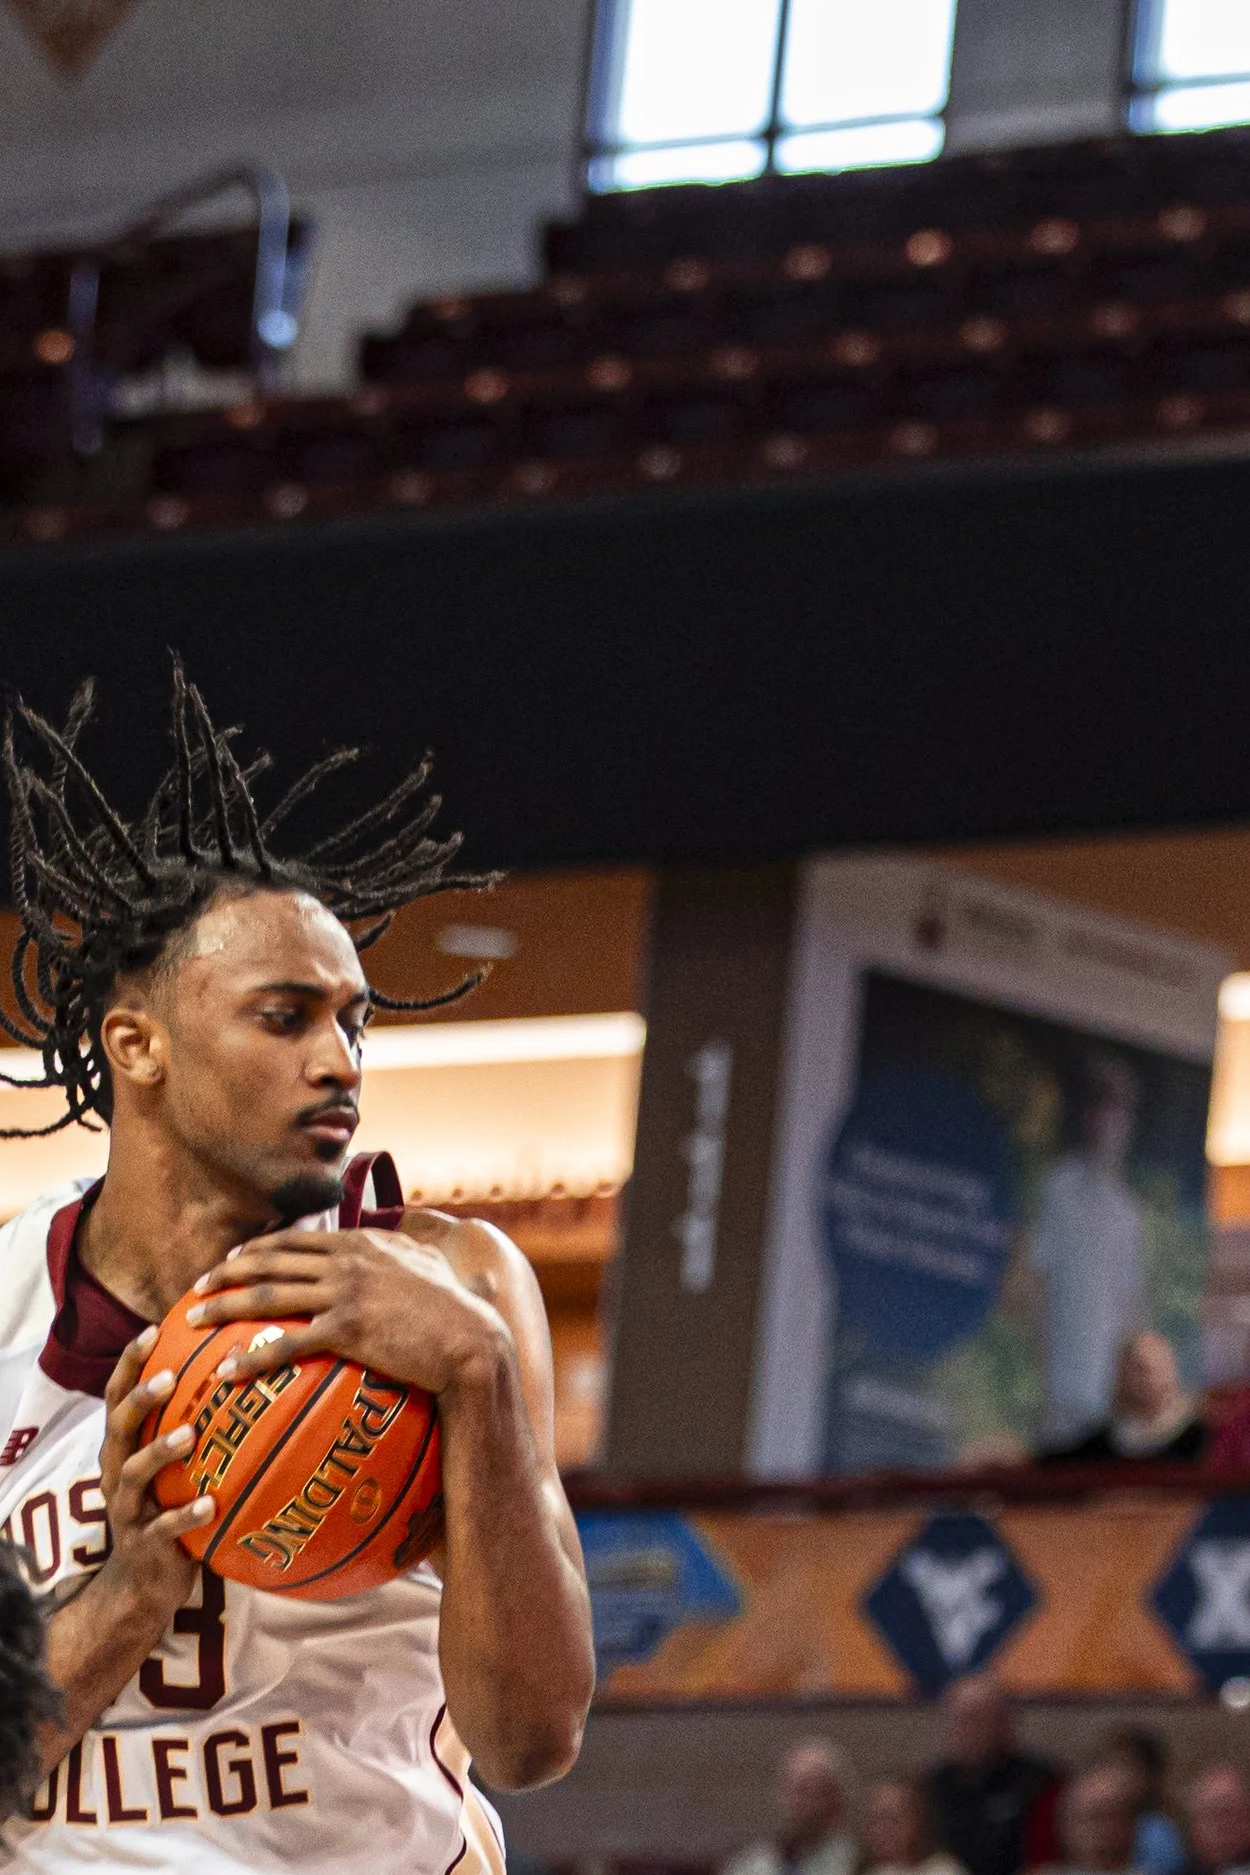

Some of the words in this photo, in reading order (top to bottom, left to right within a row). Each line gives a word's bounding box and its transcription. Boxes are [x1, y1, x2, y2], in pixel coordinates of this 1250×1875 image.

[190, 1364, 302, 1497] EGACY
[236, 1369, 409, 1573] SPALDING
[29, 1719, 310, 1824] LLEGE
